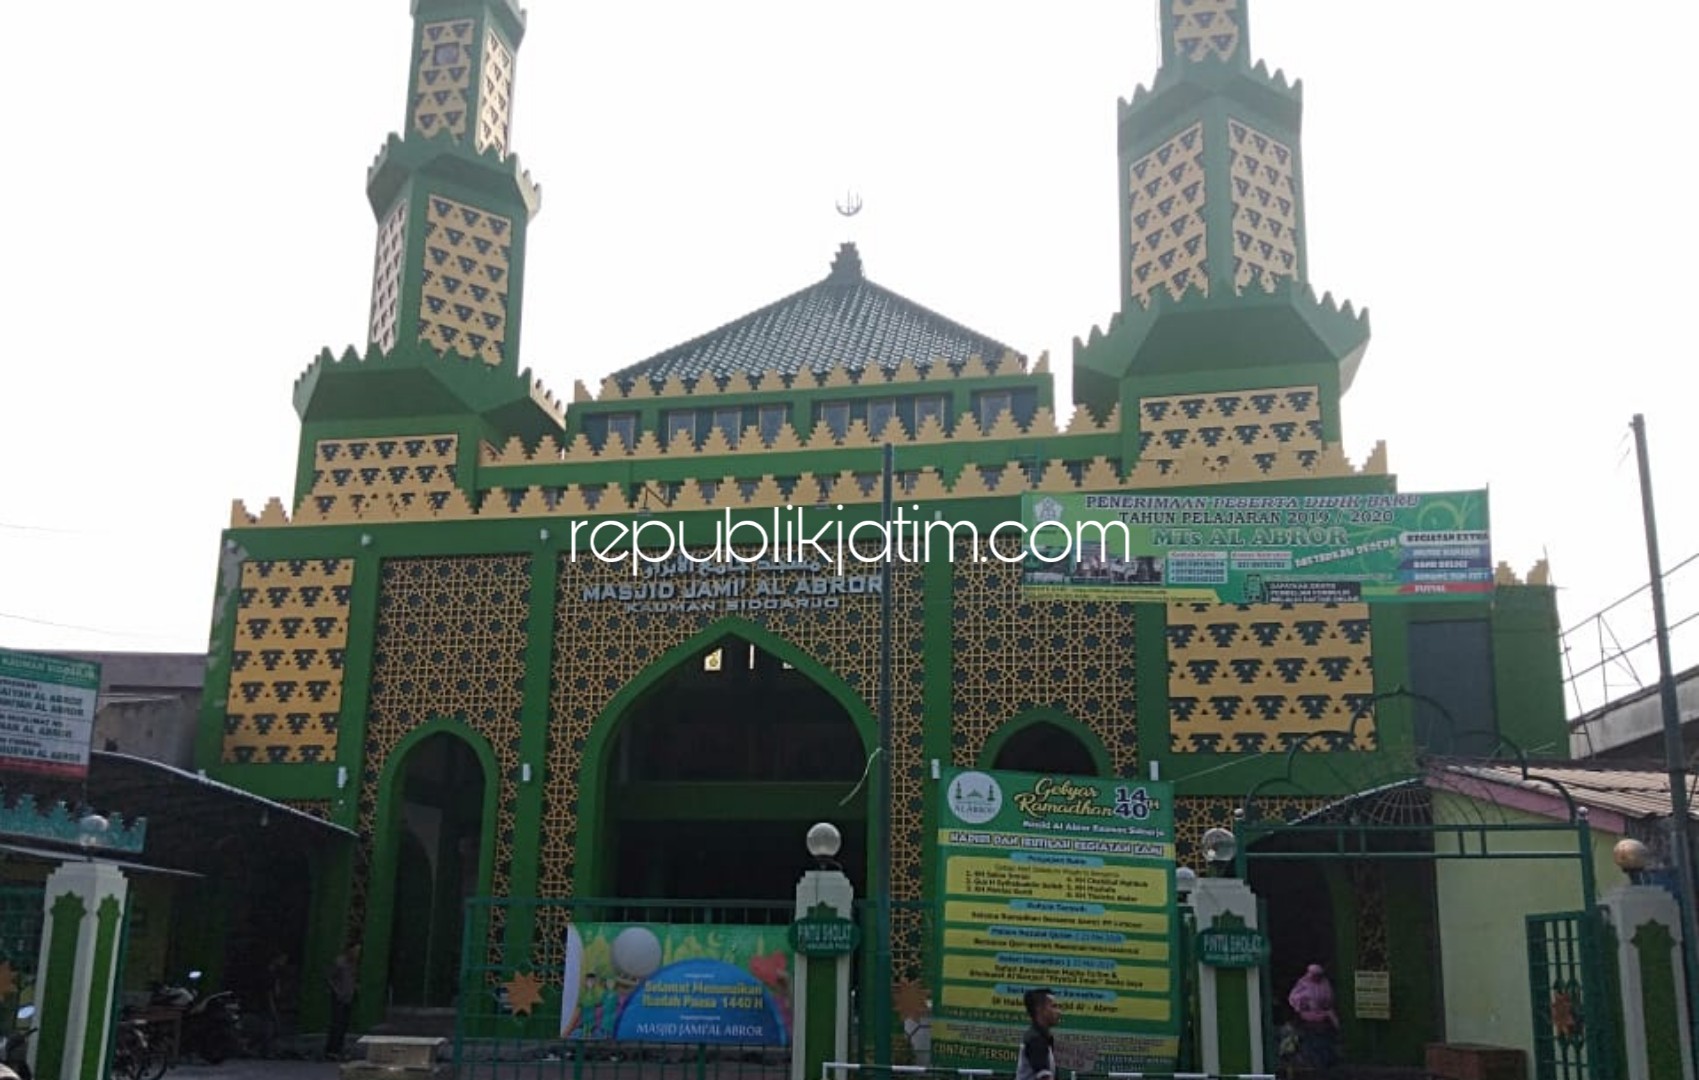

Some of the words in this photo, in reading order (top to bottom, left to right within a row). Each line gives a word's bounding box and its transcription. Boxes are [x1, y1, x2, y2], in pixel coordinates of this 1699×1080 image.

[1086, 496, 1205, 508] PENERIMAAN
[1213, 496, 1298, 508] PESERTA
[1305, 495, 1360, 508] DIDIK
[1367, 495, 1419, 508] BARU
[1118, 512, 1175, 525] TAHUN
[1182, 511, 1280, 525] PELAJARAN
[1287, 511, 1329, 524] 2019
[1350, 510, 1393, 524] 2020
[1152, 528, 1201, 546] MTs
[1204, 527, 1245, 546] AL
[1251, 526, 1350, 546] ABROR
[582, 583, 675, 601] MASJID
[757, 579, 786, 596] AL
[794, 575, 882, 596] ABROR
[626, 601, 716, 613] KAUMAN
[726, 599, 838, 611] SIDOARJO
[1034, 777, 1099, 800] Gebyar
[1014, 793, 1113, 818] Ramadhan
[993, 835, 1019, 846] DAN
[723, 996, 752, 1009] 1440
[636, 1022, 677, 1036] MASJID
[723, 1024, 764, 1037] ABROR
